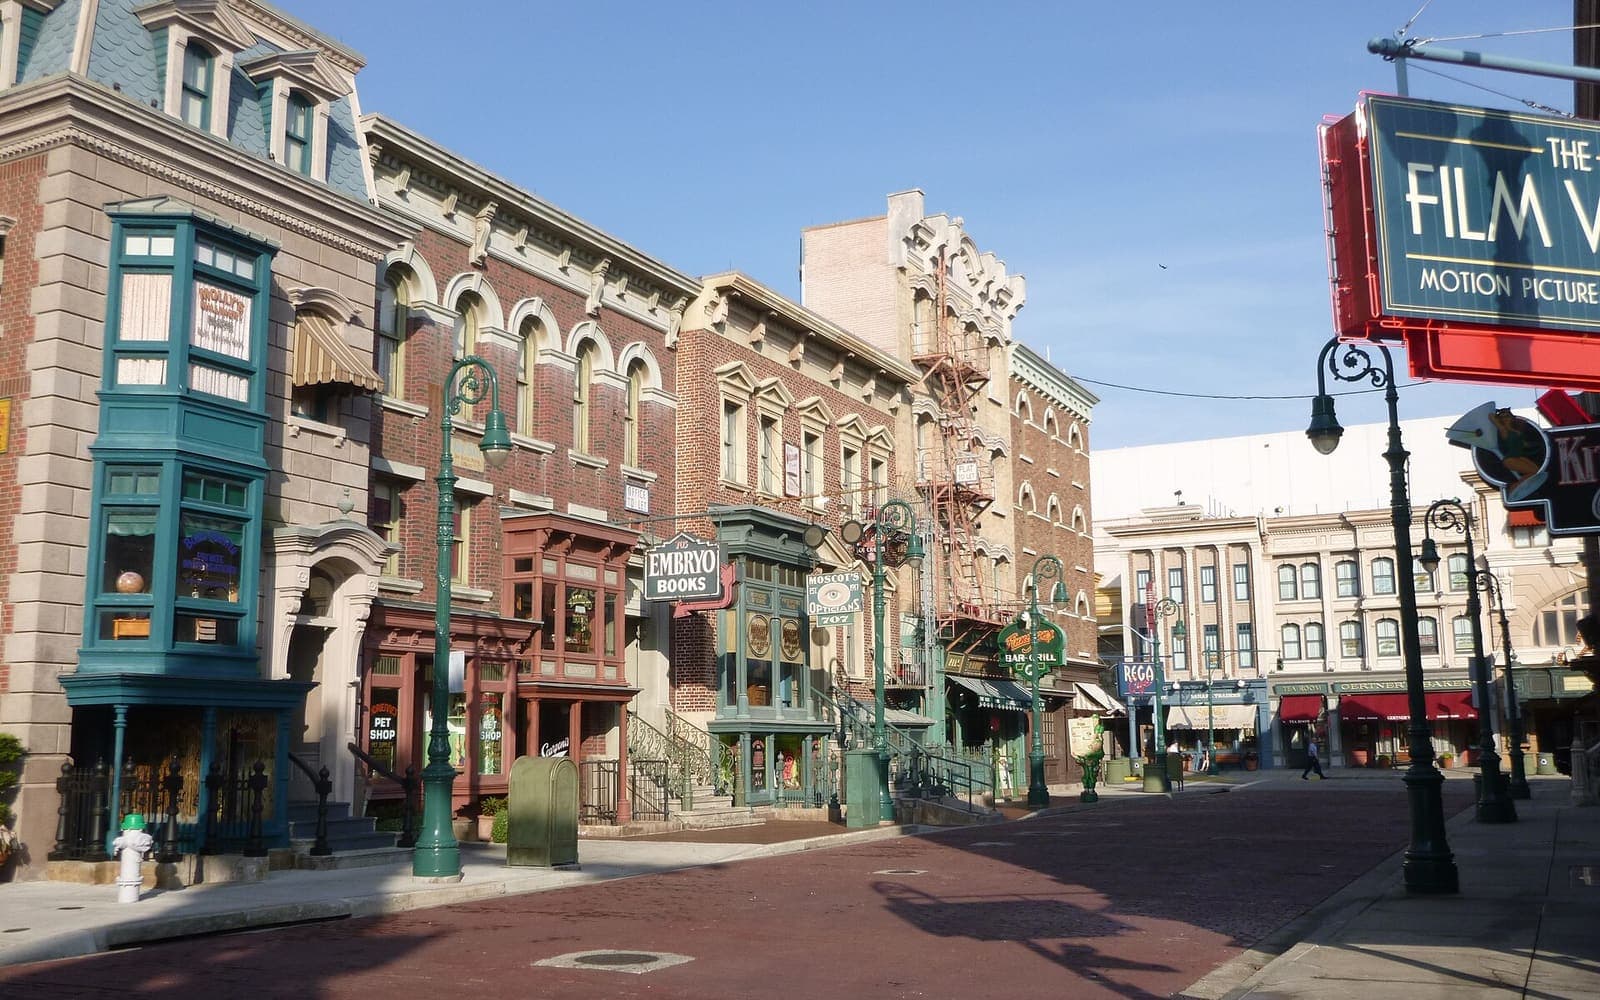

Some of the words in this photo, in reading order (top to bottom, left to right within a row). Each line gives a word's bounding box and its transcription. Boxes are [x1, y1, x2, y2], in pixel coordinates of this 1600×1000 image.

[1546, 136, 1593, 172] THE
[1405, 162, 1553, 248] FILM
[1419, 268, 1512, 297] MOTION
[1522, 276, 1598, 305] PICTURE
[958, 464, 974, 473] FLAT
[627, 486, 647, 500] OFFICE
[627, 497, 635, 508] TO
[638, 500, 647, 511] LET
[648, 549, 716, 577] EMBRYO
[657, 576, 706, 593] BOOKS
[809, 572, 860, 585] MOSCOT'S
[810, 598, 860, 614] OPTICIANS
[820, 615, 849, 625] 707
[1341, 681, 1406, 690] OERTNER'
[1423, 679, 1472, 688] BAKER
[374, 717, 392, 728] PET
[370, 729, 396, 740] SHOP
[480, 731, 502, 741] SHOP
